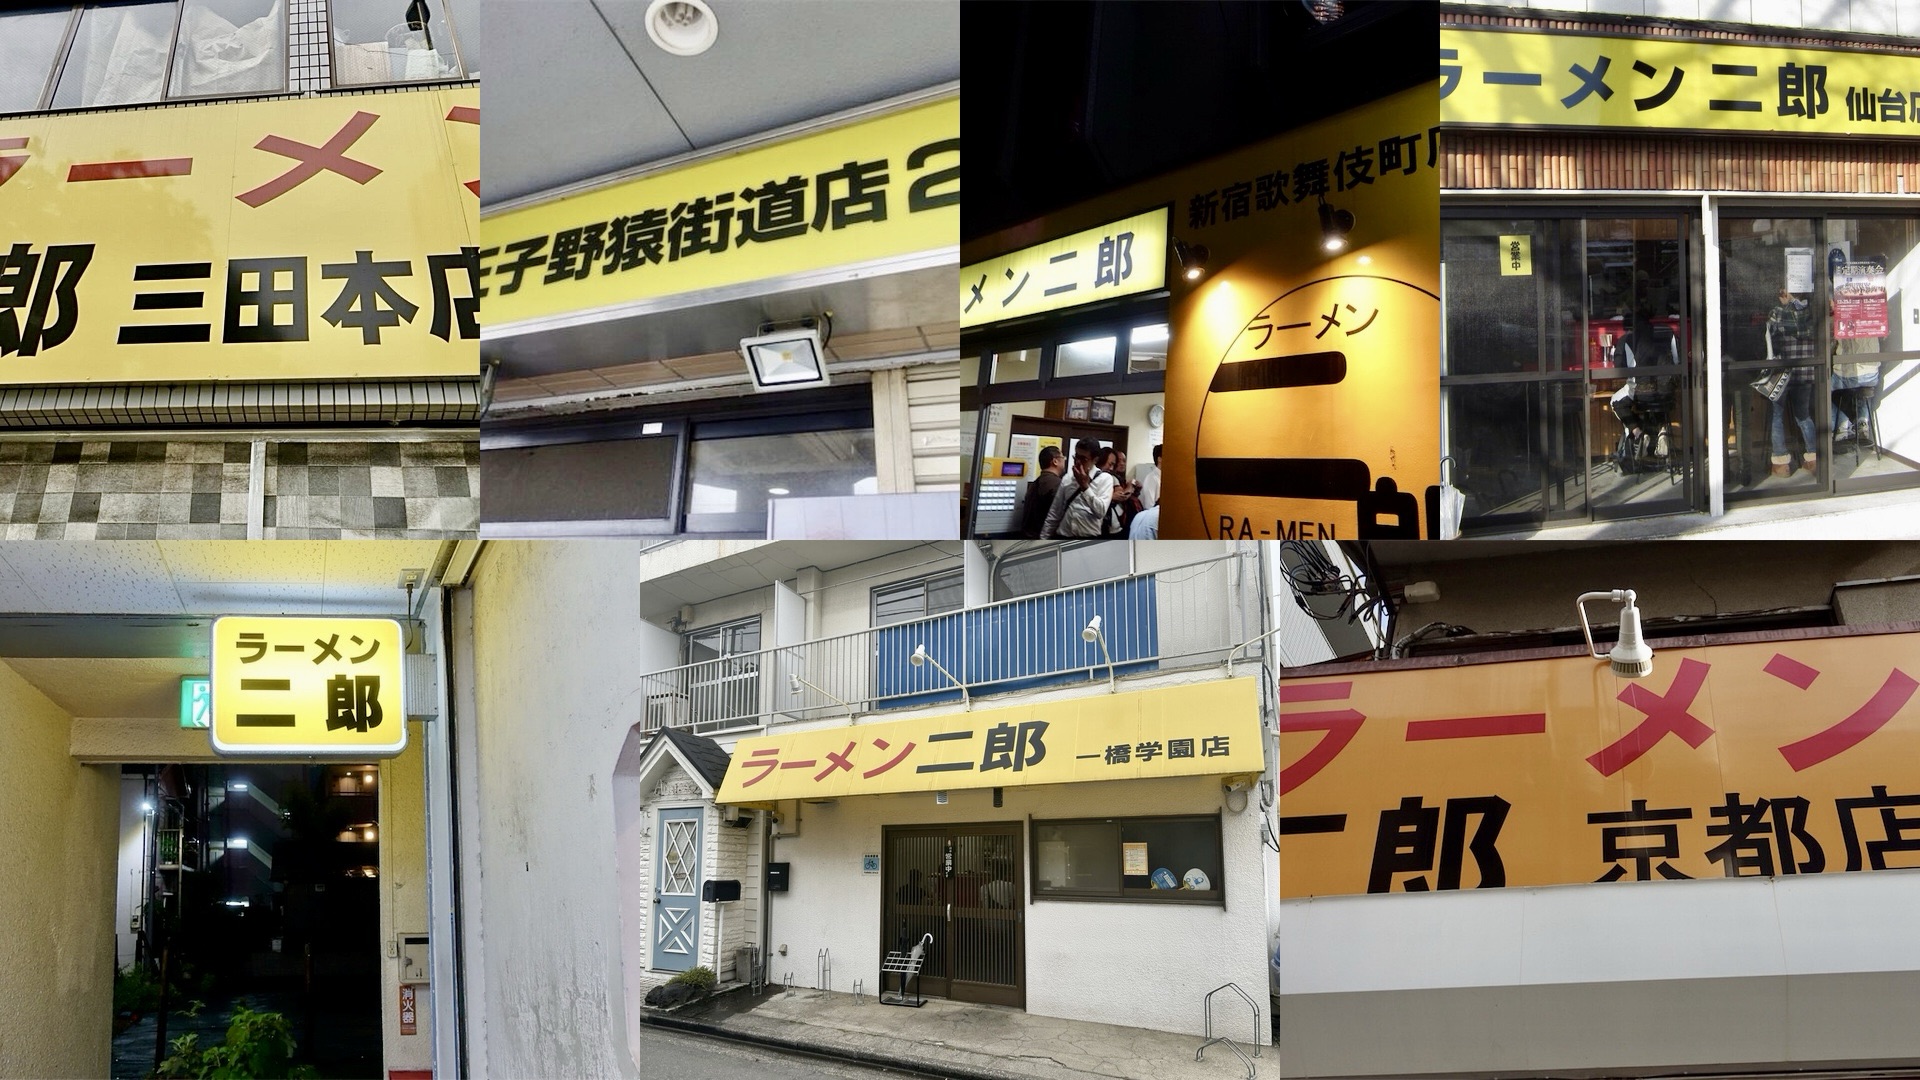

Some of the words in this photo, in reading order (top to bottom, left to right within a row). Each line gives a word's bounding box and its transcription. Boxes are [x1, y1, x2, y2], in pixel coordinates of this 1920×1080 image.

[0, 106, 480, 208] ーメ
[1188, 124, 1440, 230] 新宿歌舞伎町
[1510, 241, 1521, 271] 営業中
[1248, 304, 1379, 350] ラーメン
[236, 633, 381, 665] ラーメン
[236, 674, 383, 733] 二郎
[1280, 653, 1920, 796] ラーメン
[1076, 735, 1231, 766] 一橋学園店
[402, 988, 414, 1024] 消火器
